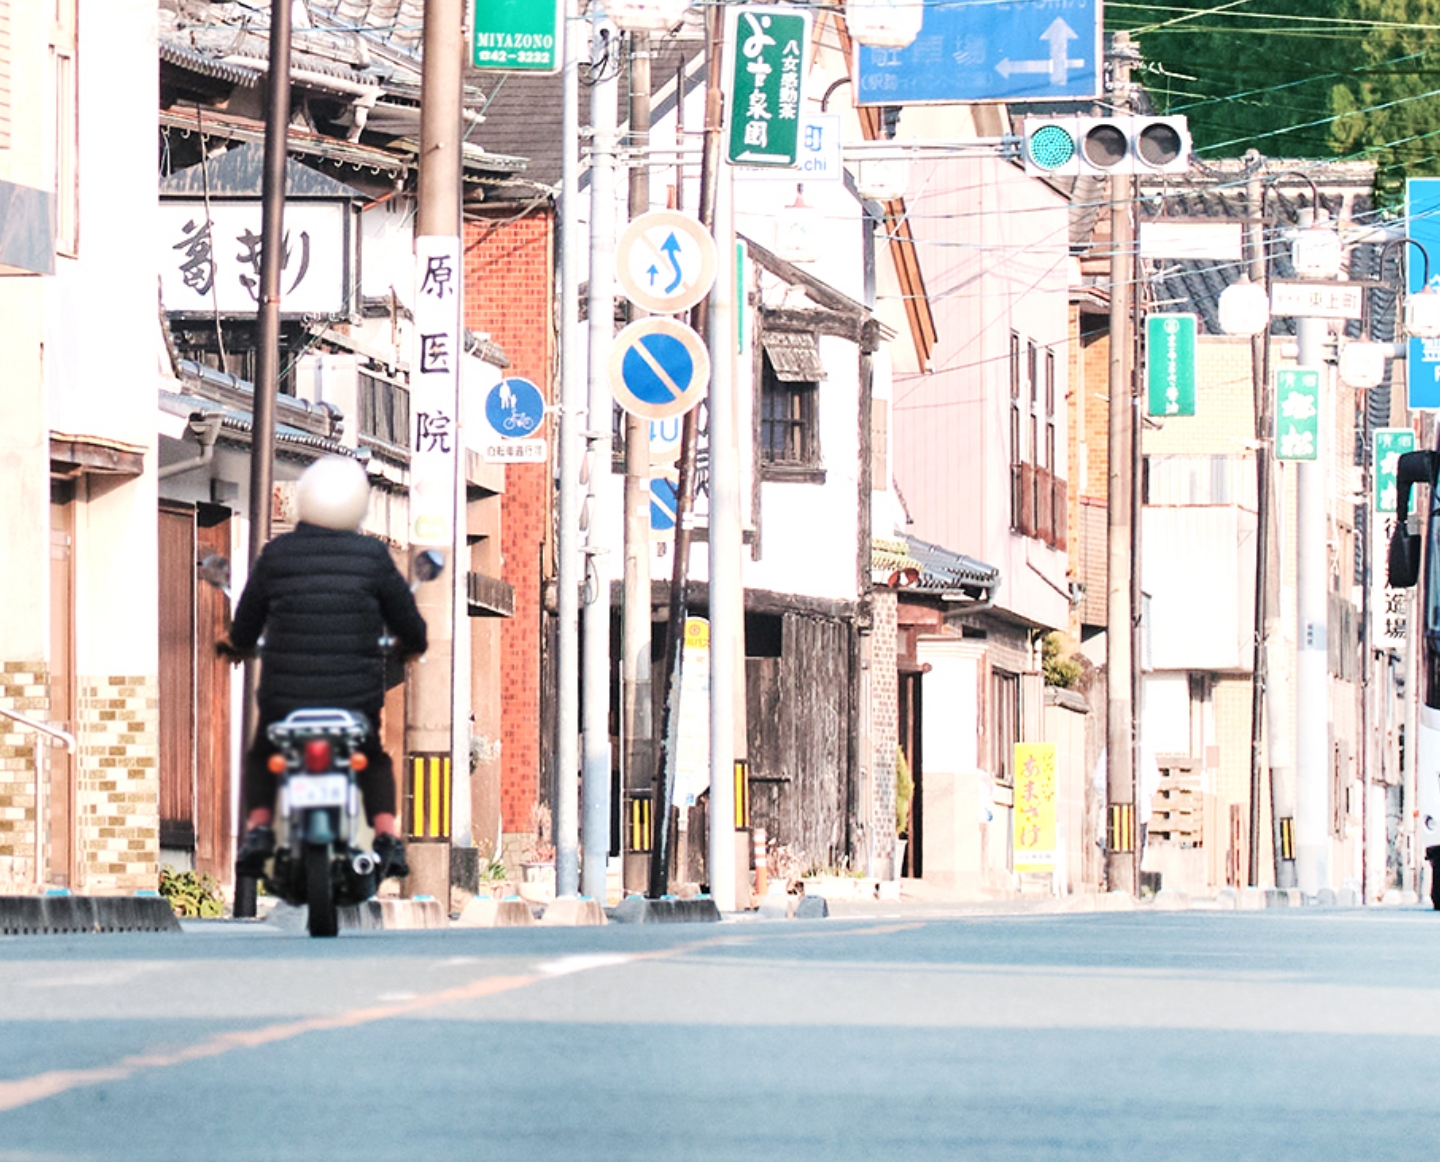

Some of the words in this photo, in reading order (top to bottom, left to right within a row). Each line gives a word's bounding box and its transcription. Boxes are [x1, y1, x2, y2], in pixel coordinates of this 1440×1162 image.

[477, 32, 553, 49] MIYAZONO
[779, 39, 800, 120] 八女感動茶
[415, 254, 455, 454] 原医院
[1020, 753, 1041, 848] あまざけ
